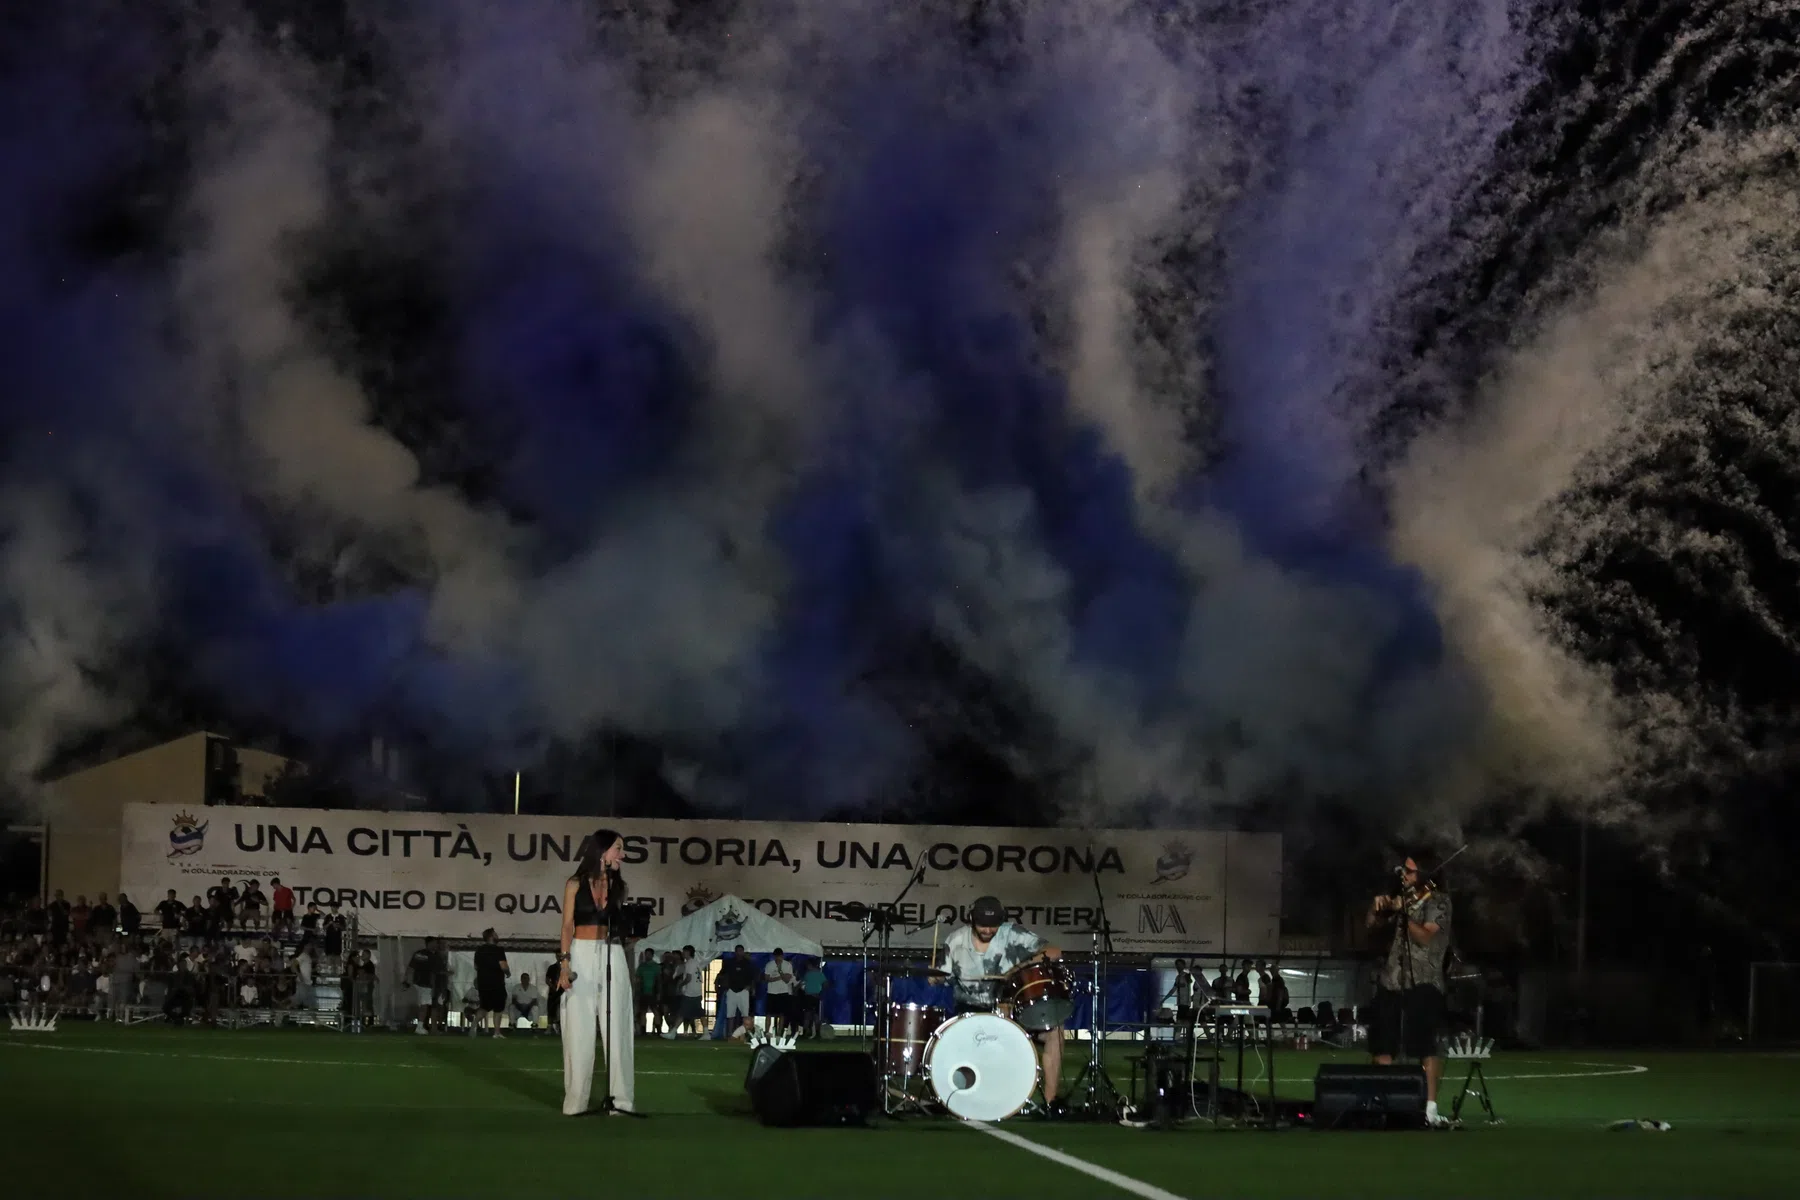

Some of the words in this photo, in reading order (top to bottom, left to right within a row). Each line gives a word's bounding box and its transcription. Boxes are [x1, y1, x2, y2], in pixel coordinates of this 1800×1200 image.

[234, 824, 333, 854] UNA
[347, 823, 492, 866] CITTÀ,
[622, 836, 801, 873] STORIA,
[817, 839, 914, 870] UNA
[926, 843, 1125, 875] CORONA
[191, 868, 261, 877] COLLABORAZIONE
[293, 886, 426, 910] TORNEO
[437, 892, 485, 912] DEI
[936, 904, 1102, 926] QURTIERI
